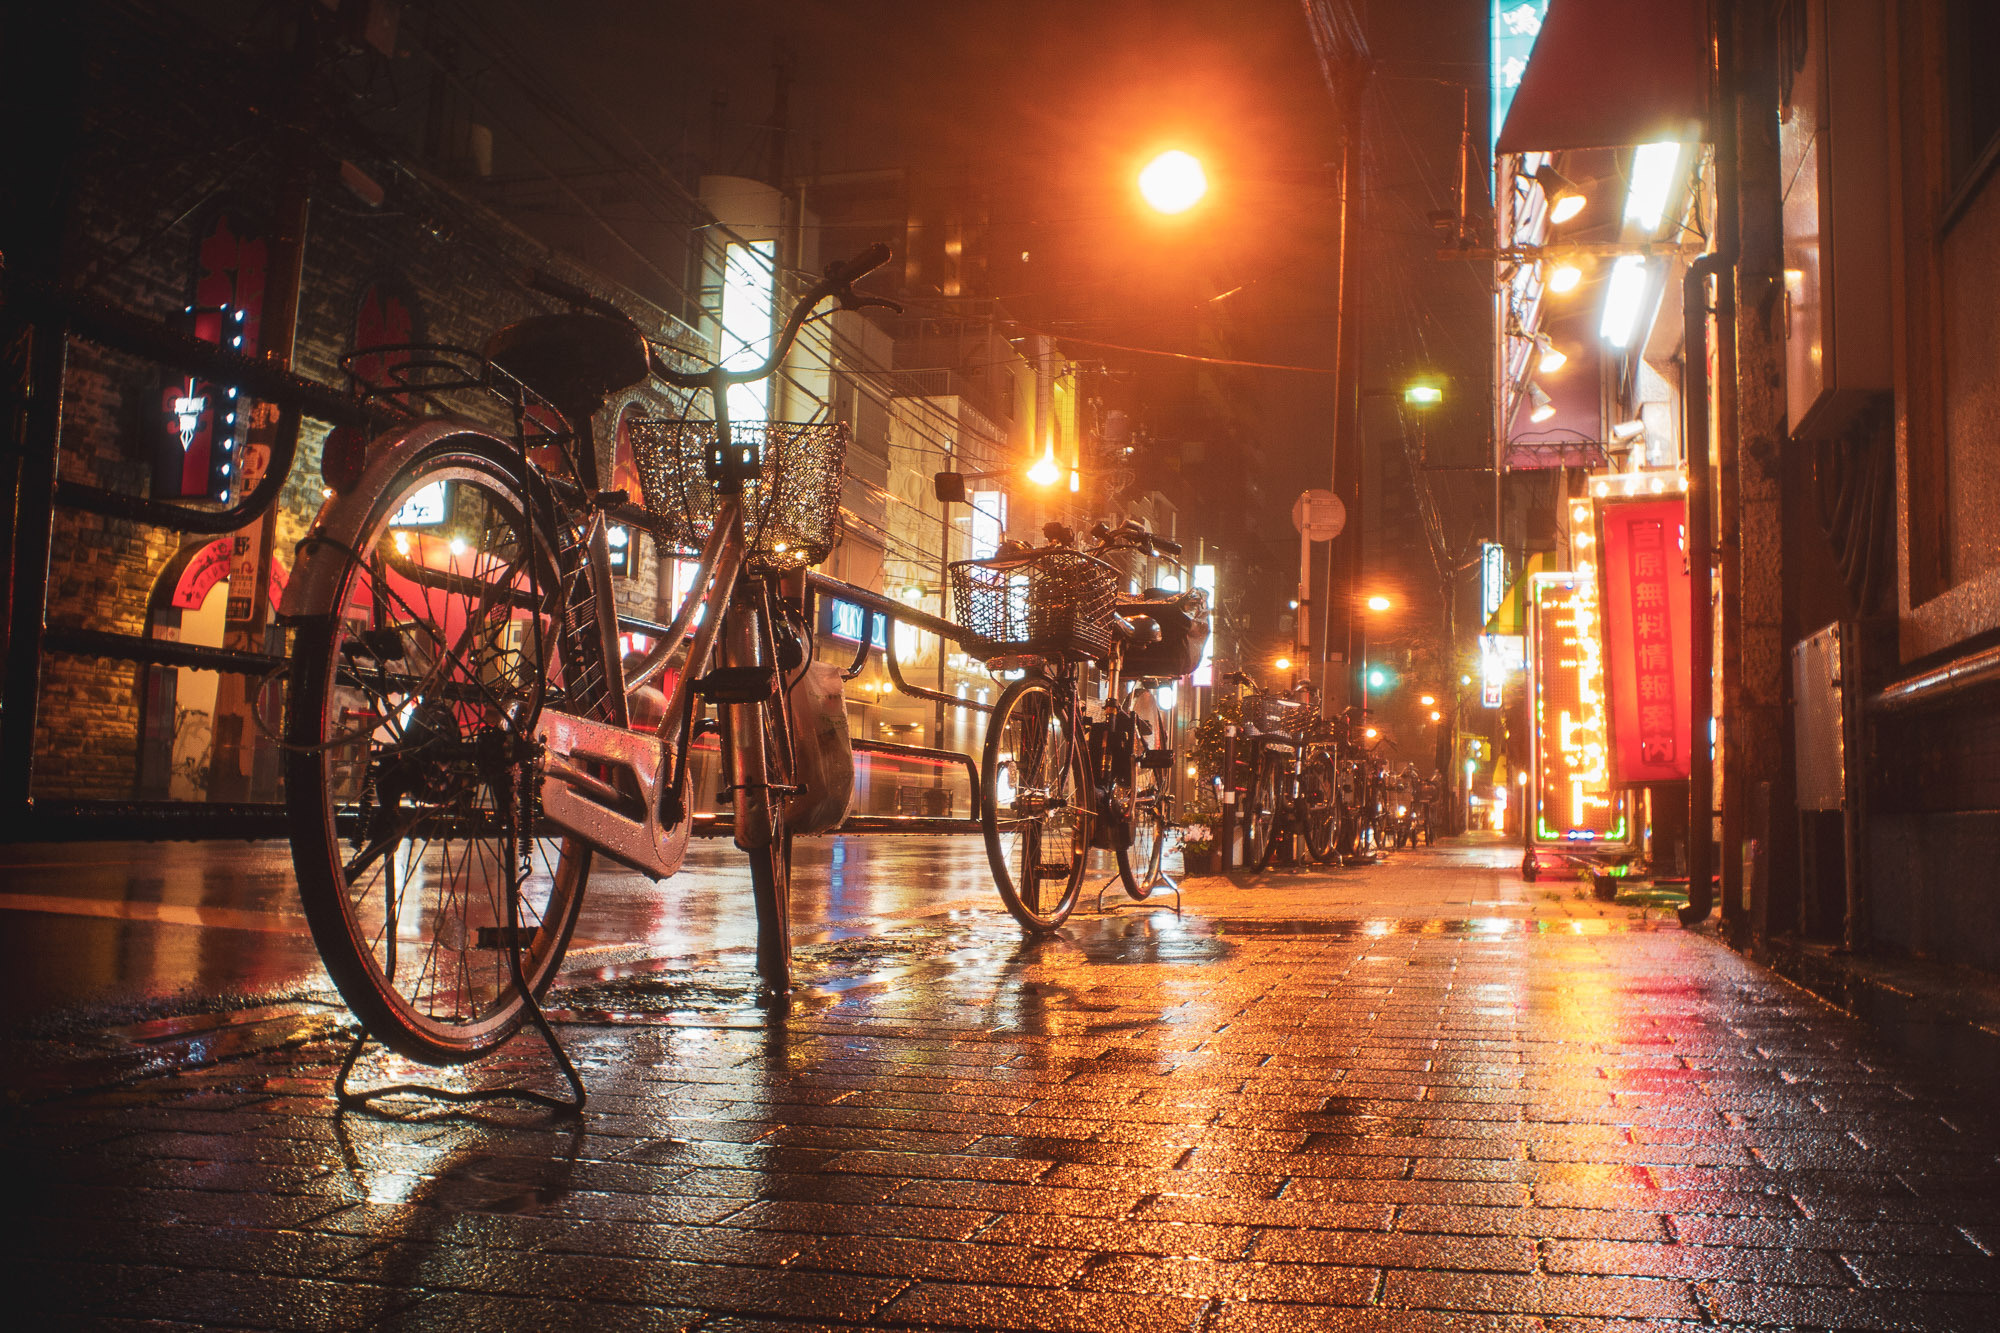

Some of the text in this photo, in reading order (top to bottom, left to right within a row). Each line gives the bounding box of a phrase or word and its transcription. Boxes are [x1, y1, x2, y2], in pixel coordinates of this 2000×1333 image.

[1631, 520, 1673, 762] 吉原無料情報案内
